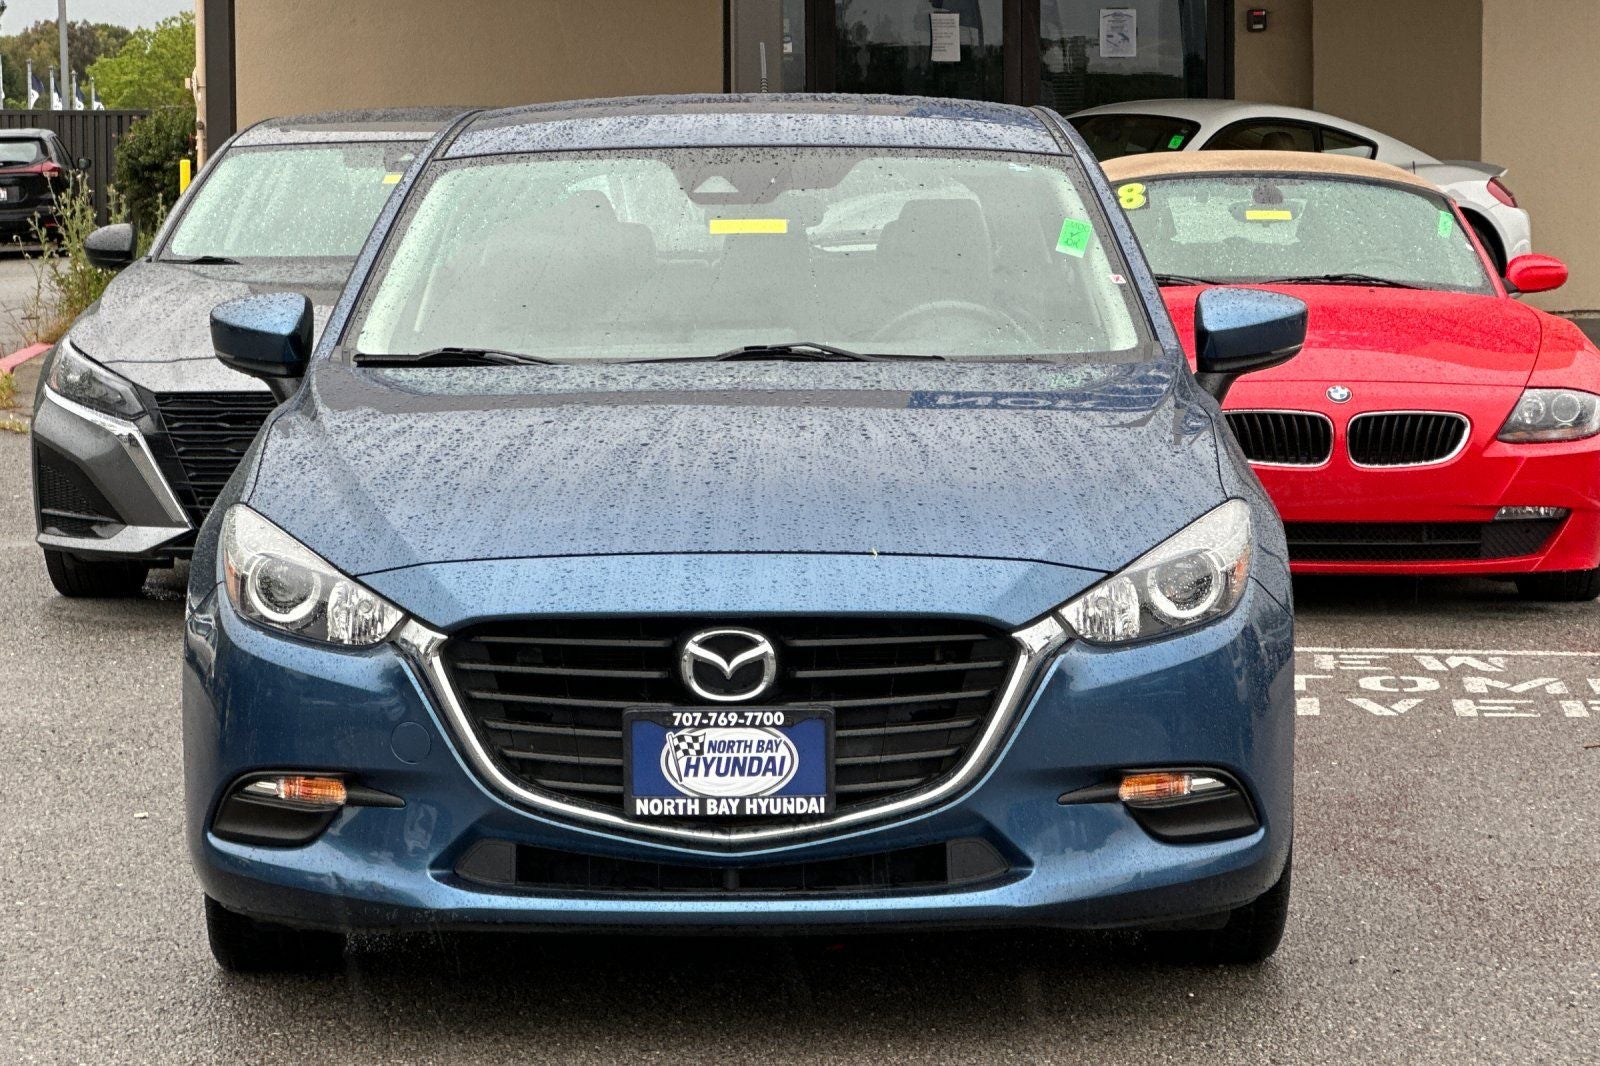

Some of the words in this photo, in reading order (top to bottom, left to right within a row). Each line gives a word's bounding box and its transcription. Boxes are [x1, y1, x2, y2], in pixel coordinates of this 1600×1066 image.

[1314, 654, 1504, 671] EW
[1296, 698, 1600, 717] IVE
[672, 712, 785, 726] 707-769-7700
[707, 740, 753, 754] NORTH
[756, 739, 782, 753] BAY
[684, 756, 786, 777] HYUNDAI
[635, 798, 699, 815] NORTH
[707, 798, 739, 815] BAY
[746, 797, 825, 814] HYUNDAI
